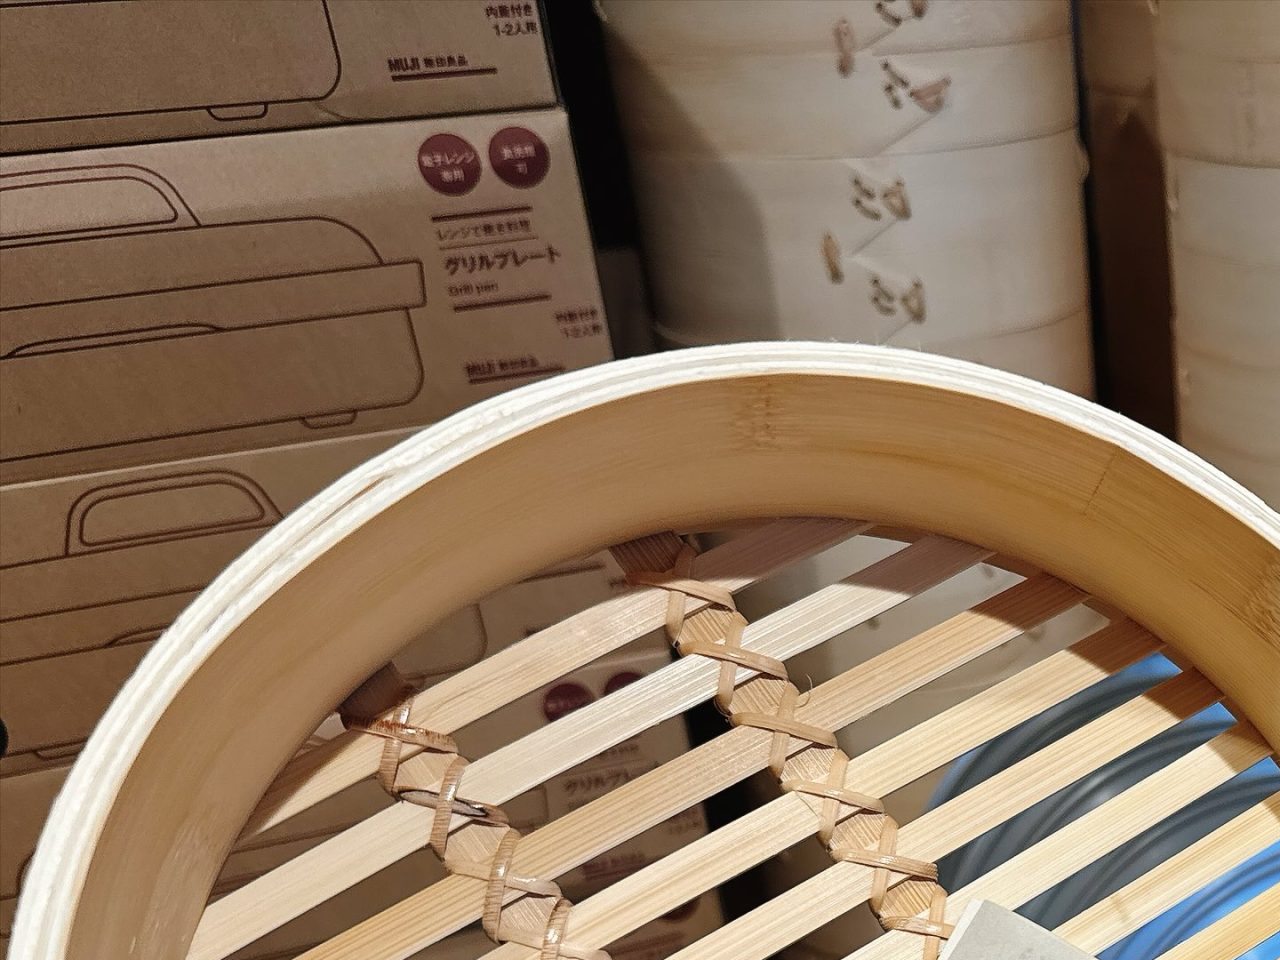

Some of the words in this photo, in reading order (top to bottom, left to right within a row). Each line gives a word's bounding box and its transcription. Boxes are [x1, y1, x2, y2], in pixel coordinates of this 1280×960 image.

[388, 56, 421, 72] MUJI
[445, 245, 560, 275] グリルプレート
